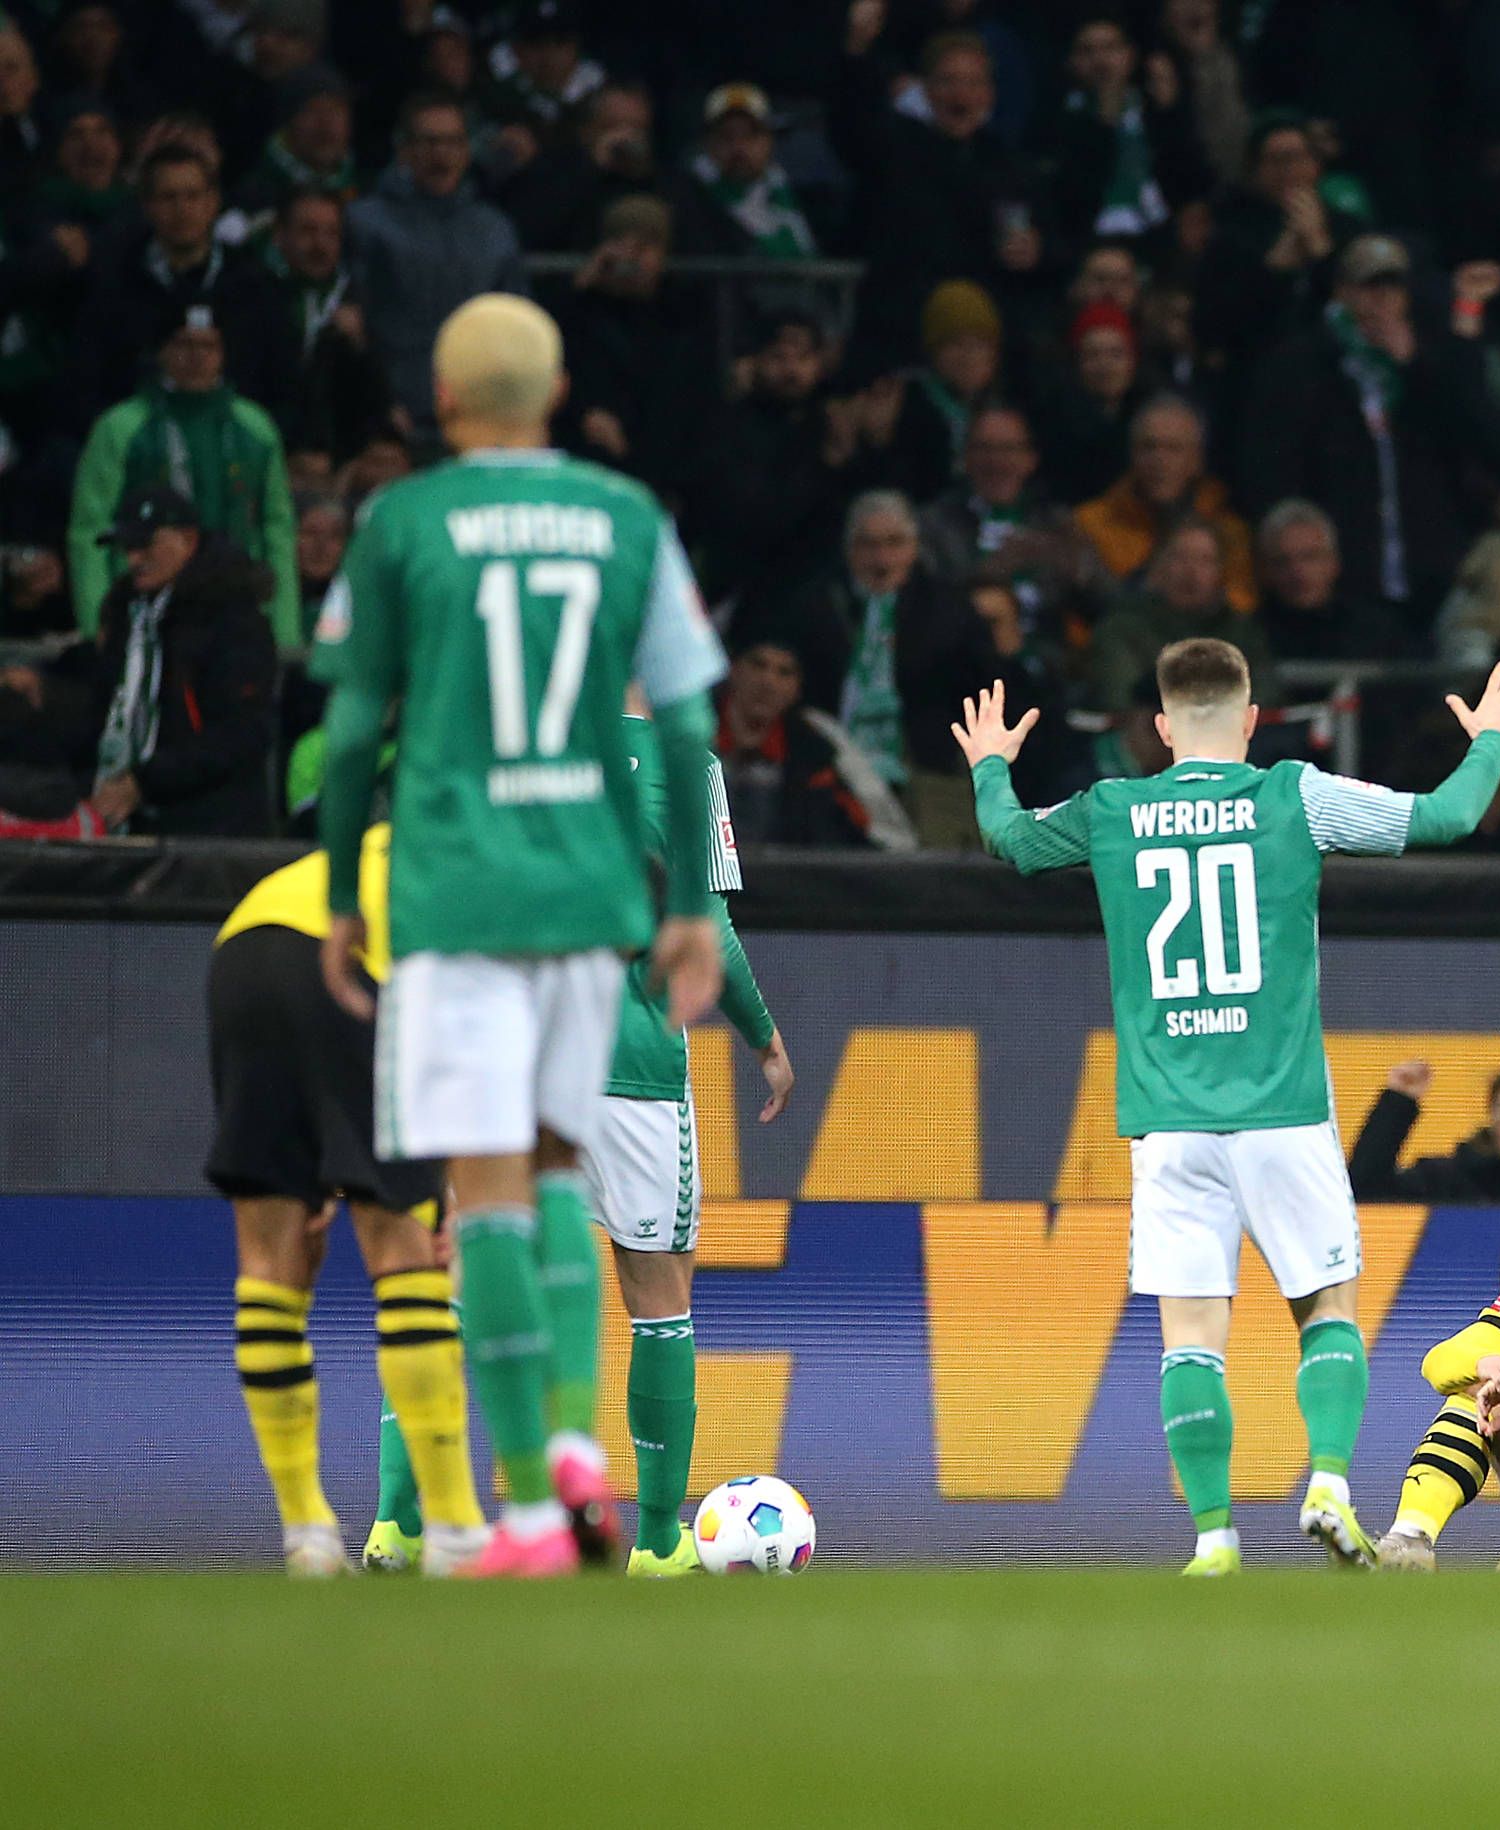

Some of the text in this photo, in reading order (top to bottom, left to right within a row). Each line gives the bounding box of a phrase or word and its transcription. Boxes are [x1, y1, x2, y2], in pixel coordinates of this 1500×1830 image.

[476, 559, 602, 758] 17
[1130, 799, 1257, 838] WERDER
[1135, 842, 1262, 1000] 20
[1166, 1006, 1248, 1038] SCHMID
